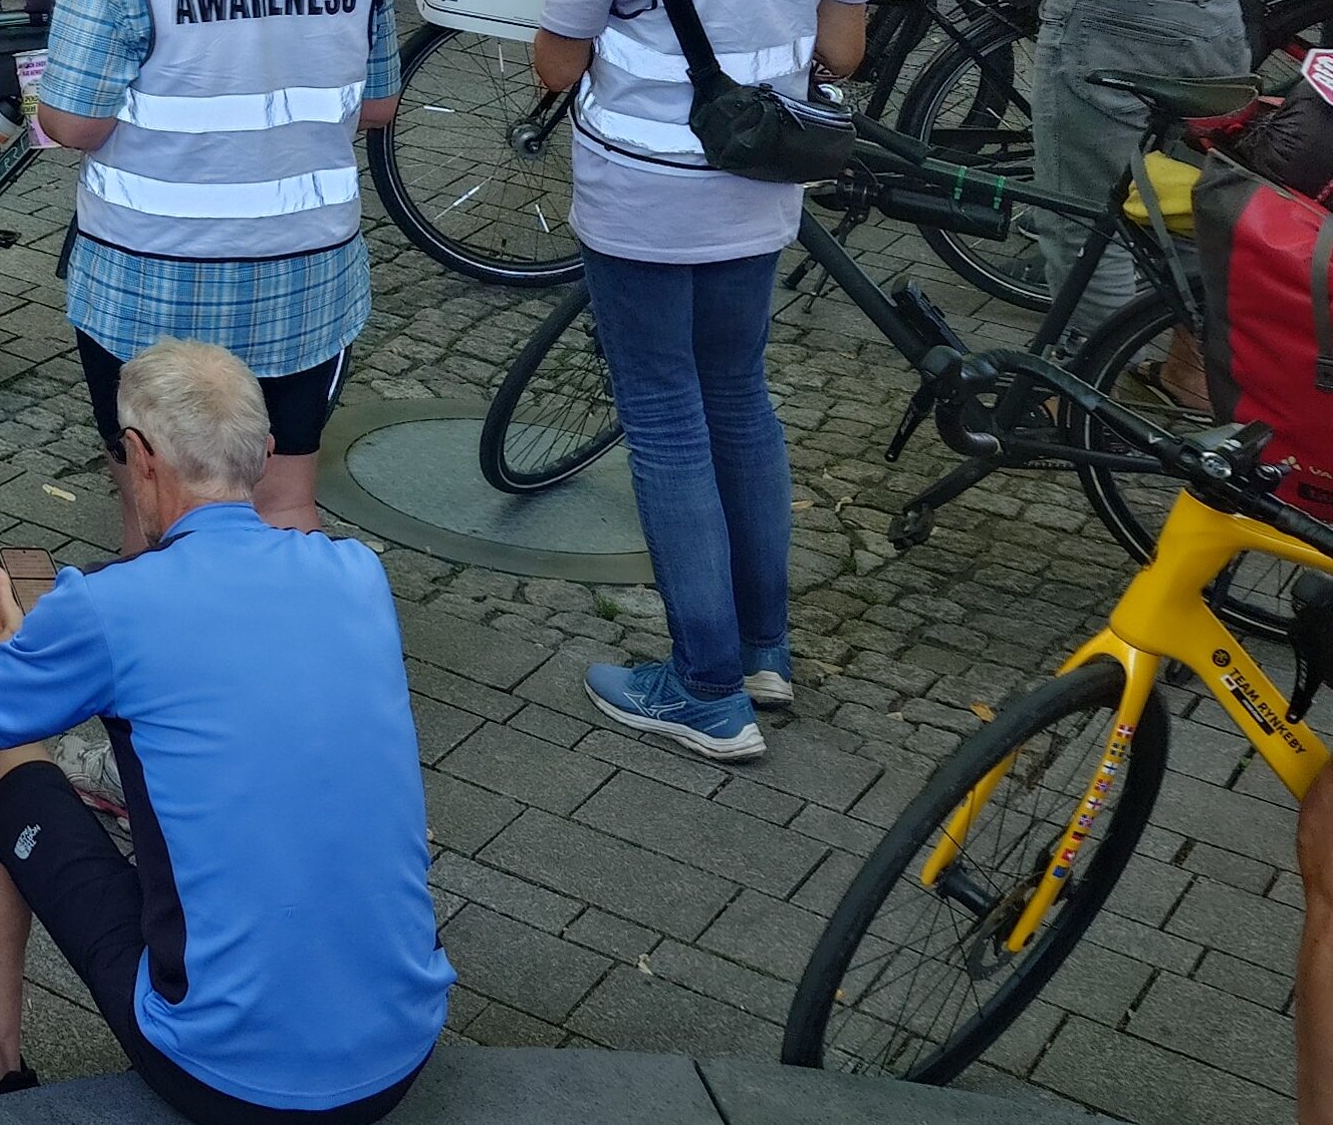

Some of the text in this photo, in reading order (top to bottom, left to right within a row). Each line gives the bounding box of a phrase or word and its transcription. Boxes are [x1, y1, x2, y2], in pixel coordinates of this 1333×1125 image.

[1308, 465, 1333, 480] VA
[1228, 667, 1261, 703] TEAM
[1257, 702, 1307, 755] RYNKEBY
